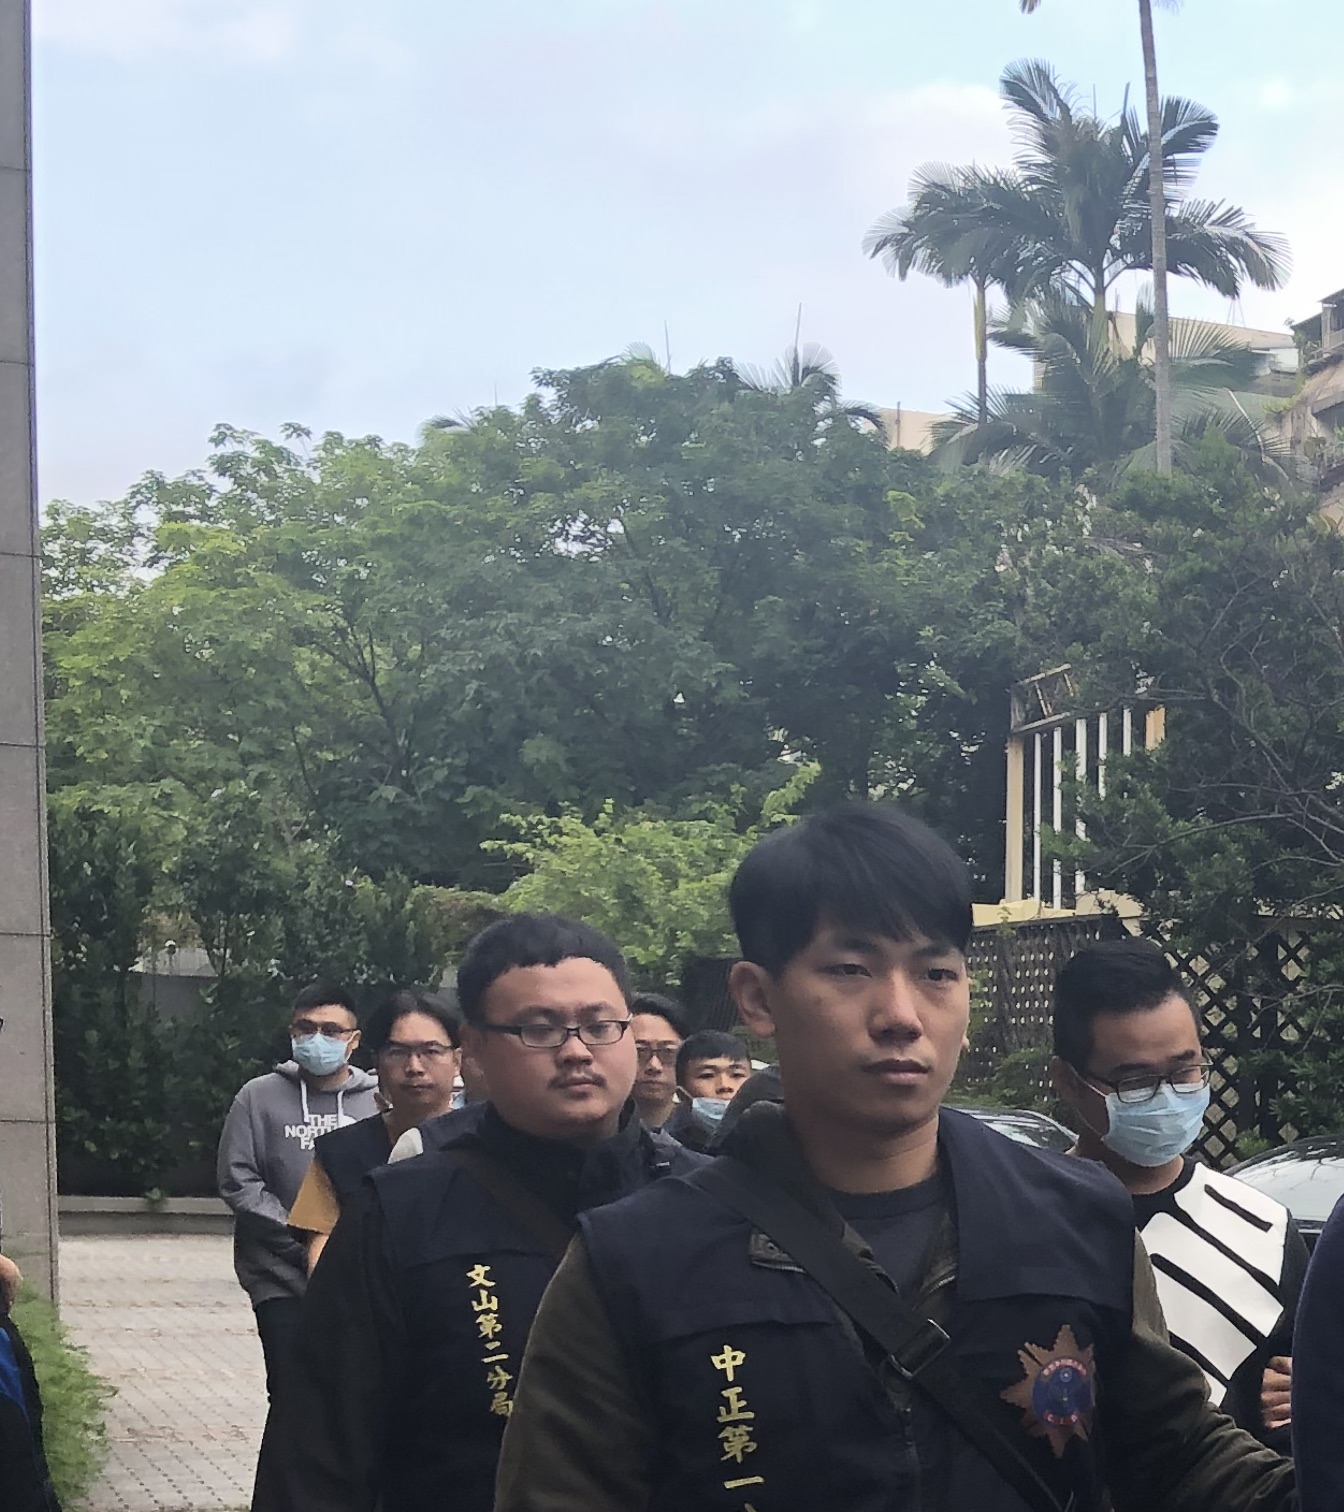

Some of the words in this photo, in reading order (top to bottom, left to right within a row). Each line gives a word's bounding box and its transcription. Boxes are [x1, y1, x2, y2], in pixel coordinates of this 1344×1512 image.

[306, 1114, 338, 1127] THE
[466, 1264, 513, 1417] 文山第二分局
